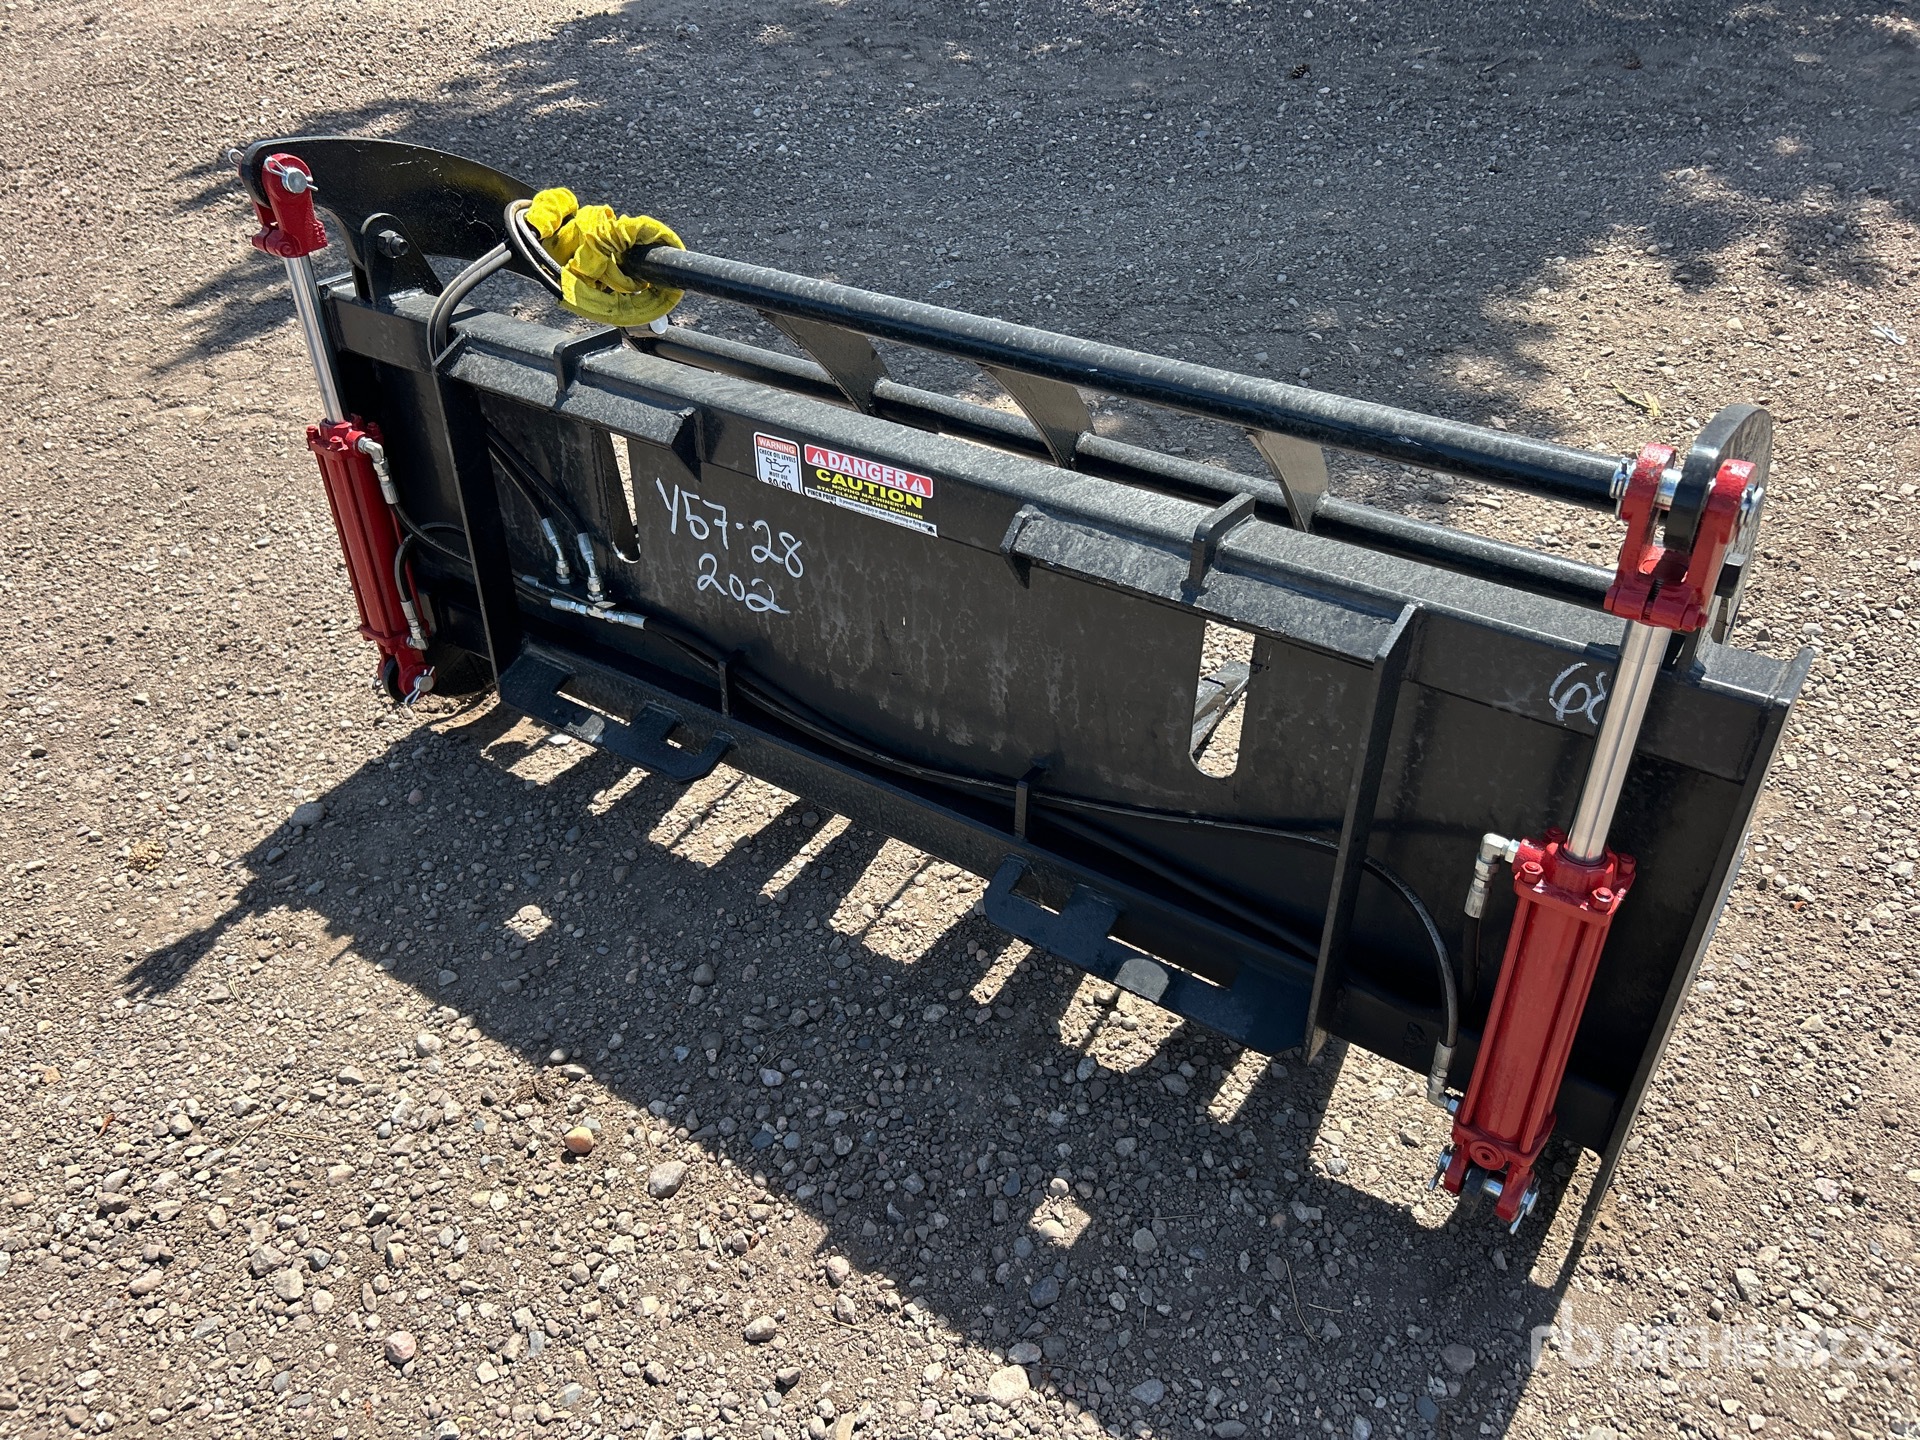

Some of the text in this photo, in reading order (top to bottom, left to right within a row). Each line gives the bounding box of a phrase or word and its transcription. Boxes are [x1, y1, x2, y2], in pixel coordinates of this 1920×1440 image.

[759, 438, 795, 454] WARNING
[759, 448, 773, 457] CHECK
[773, 452, 781, 460] OIL
[827, 452, 909, 490] DANGER
[807, 488, 837, 502] PINCH POINT
[815, 468, 923, 509] CAUTION
[816, 484, 834, 494] STAY
[835, 490, 859, 501] CLEAR
[870, 500, 888, 510] THIS
[889, 505, 924, 520] MACHINE
[831, 484, 907, 510] MOVING MACHINERY!
[697, 552, 791, 615] 202
